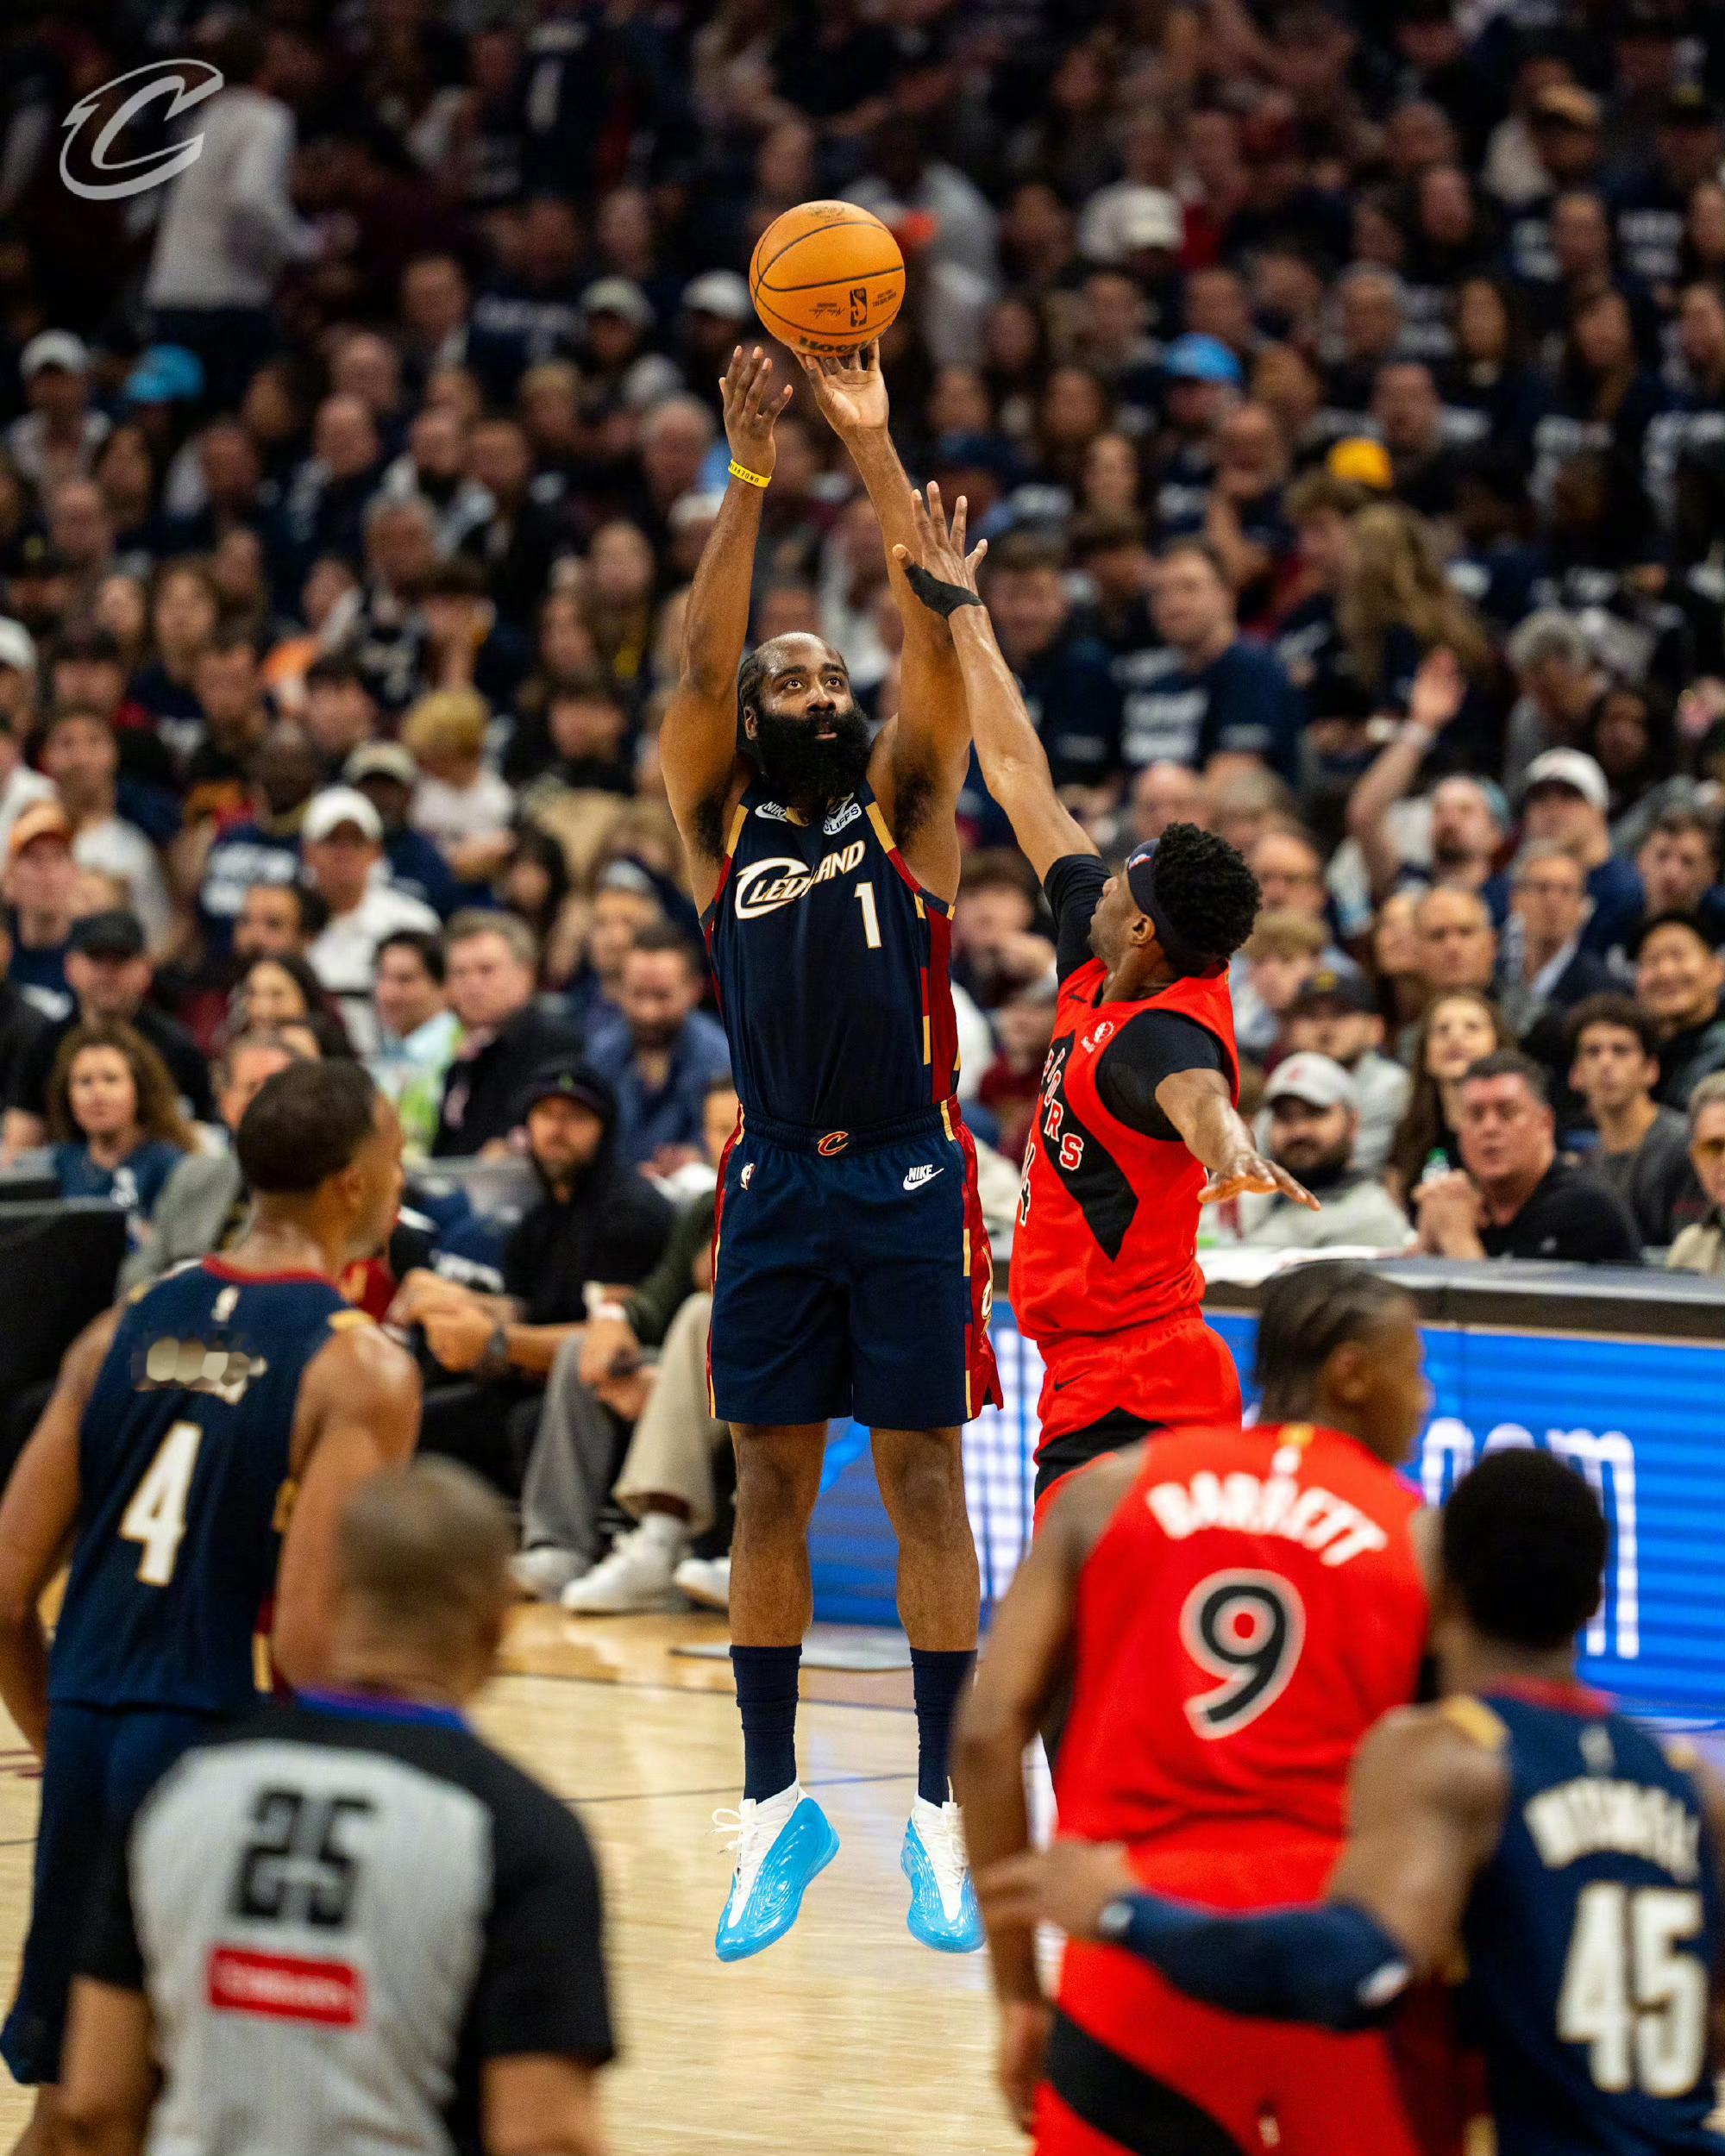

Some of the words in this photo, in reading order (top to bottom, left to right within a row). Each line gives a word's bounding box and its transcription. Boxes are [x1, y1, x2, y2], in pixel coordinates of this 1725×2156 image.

[823, 805, 860, 832] CLIFFS
[854, 881, 881, 949] 1
[907, 1163, 933, 1181] NIKE
[118, 1420, 204, 1588] 4
[1179, 1568, 1307, 1740] 9
[231, 1782, 380, 1930] 25
[1557, 1880, 1709, 2097] 45
